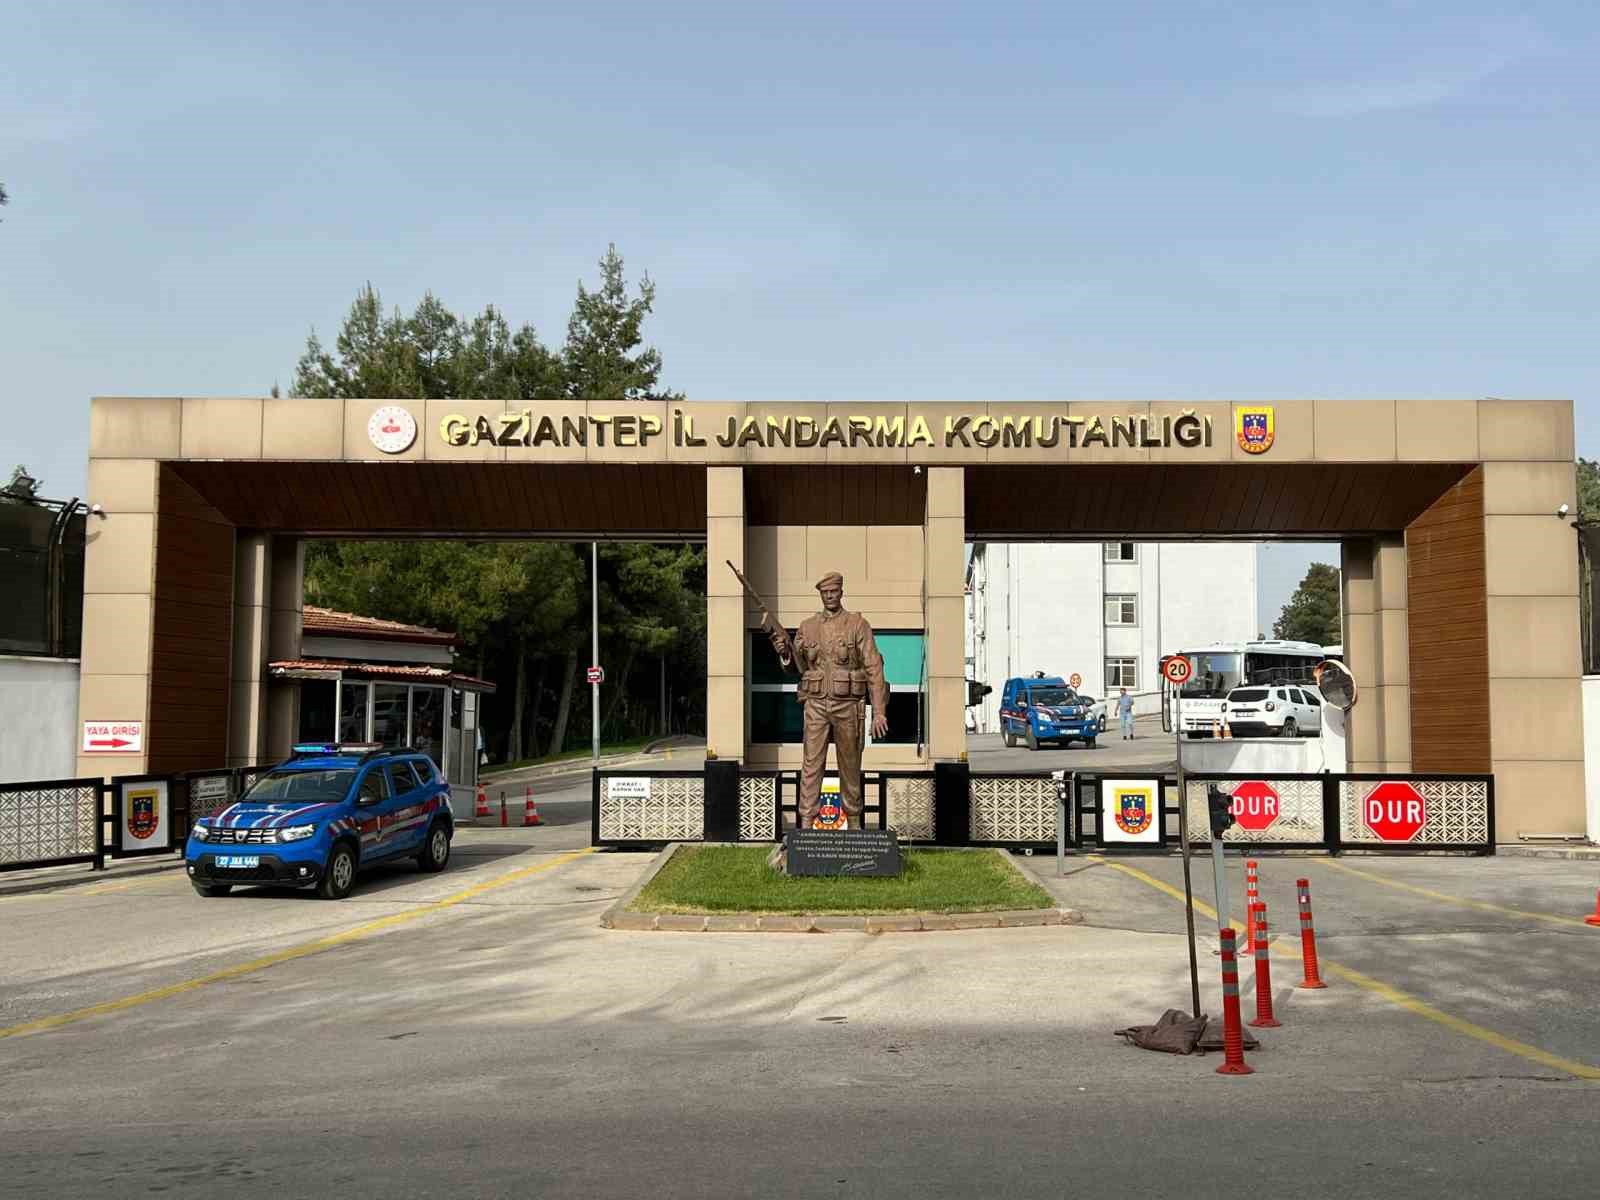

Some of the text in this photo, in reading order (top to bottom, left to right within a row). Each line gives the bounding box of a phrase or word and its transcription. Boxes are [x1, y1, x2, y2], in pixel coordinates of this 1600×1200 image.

[439, 408, 1212, 448] GAZİANTEP İL JANDARMA KOMUTANLIĞI
[1170, 663, 1186, 676] 20
[87, 726, 109, 736] YAYA
[1233, 796, 1276, 816] DUR
[1369, 800, 1421, 824] DUR
